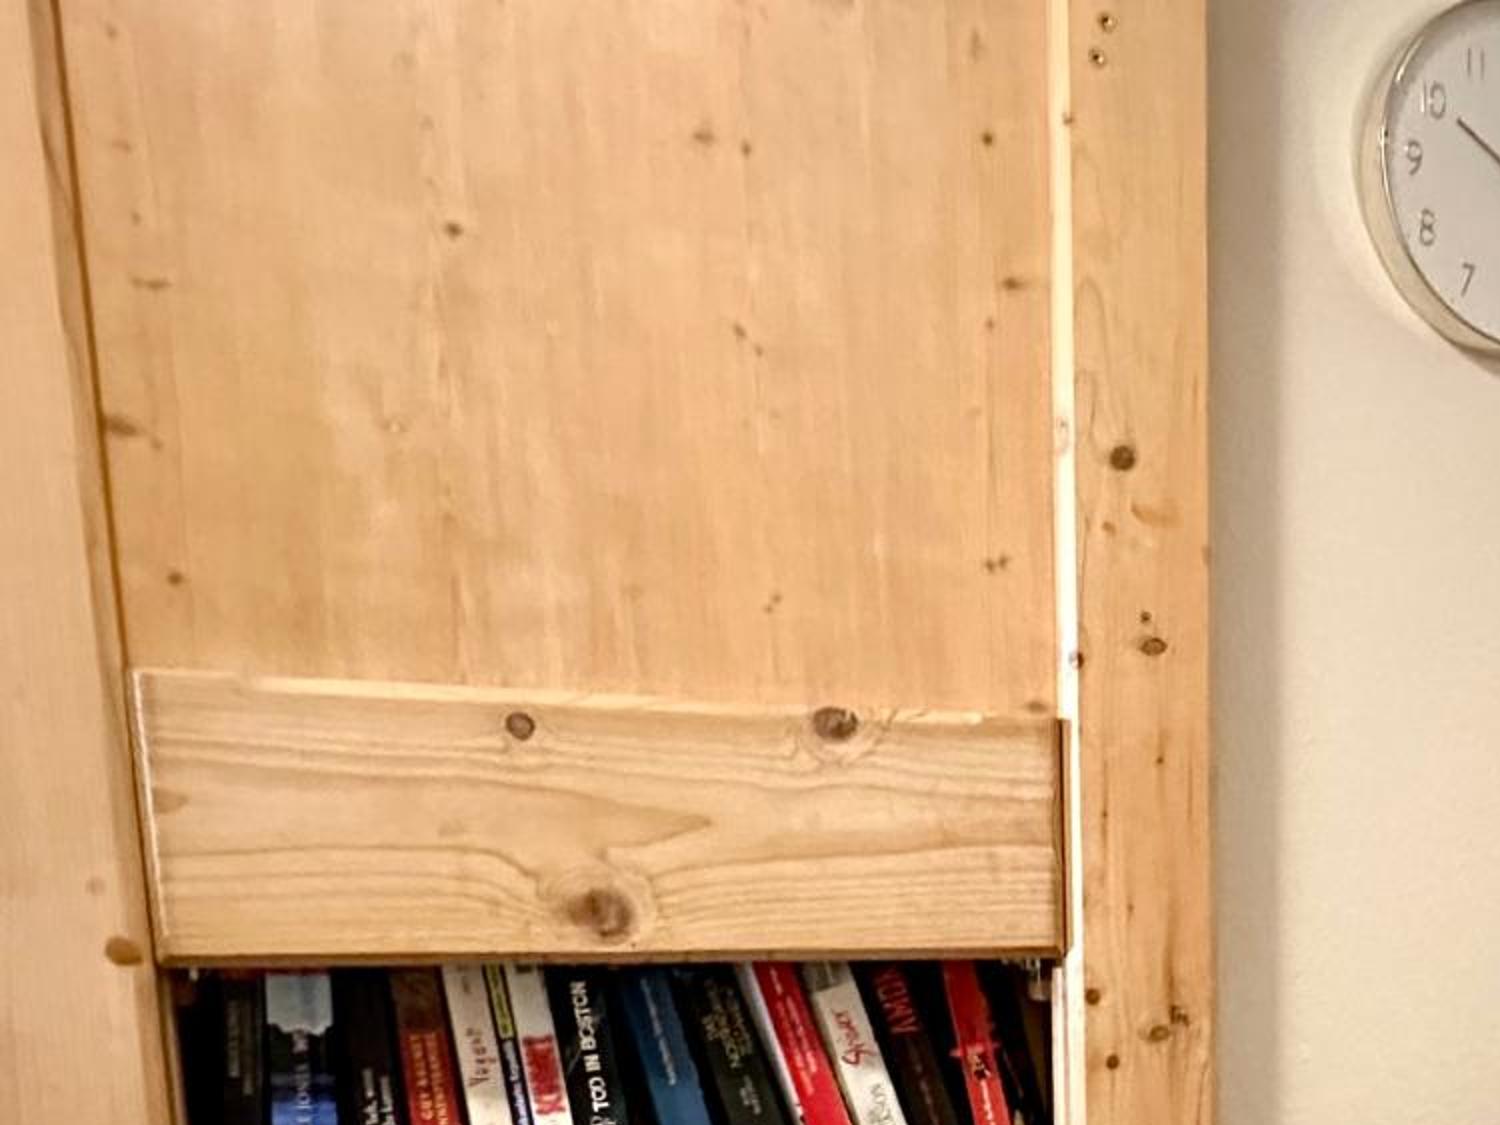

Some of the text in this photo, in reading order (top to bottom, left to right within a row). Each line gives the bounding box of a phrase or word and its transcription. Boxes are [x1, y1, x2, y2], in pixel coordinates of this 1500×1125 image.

[1466, 47, 1485, 81] 11
[1420, 82, 1447, 120] 10
[1407, 139, 1422, 176] 9
[1419, 208, 1437, 247] 8
[1462, 262, 1475, 297] 7
[570, 981, 609, 1112] TOD IN BOSTON
